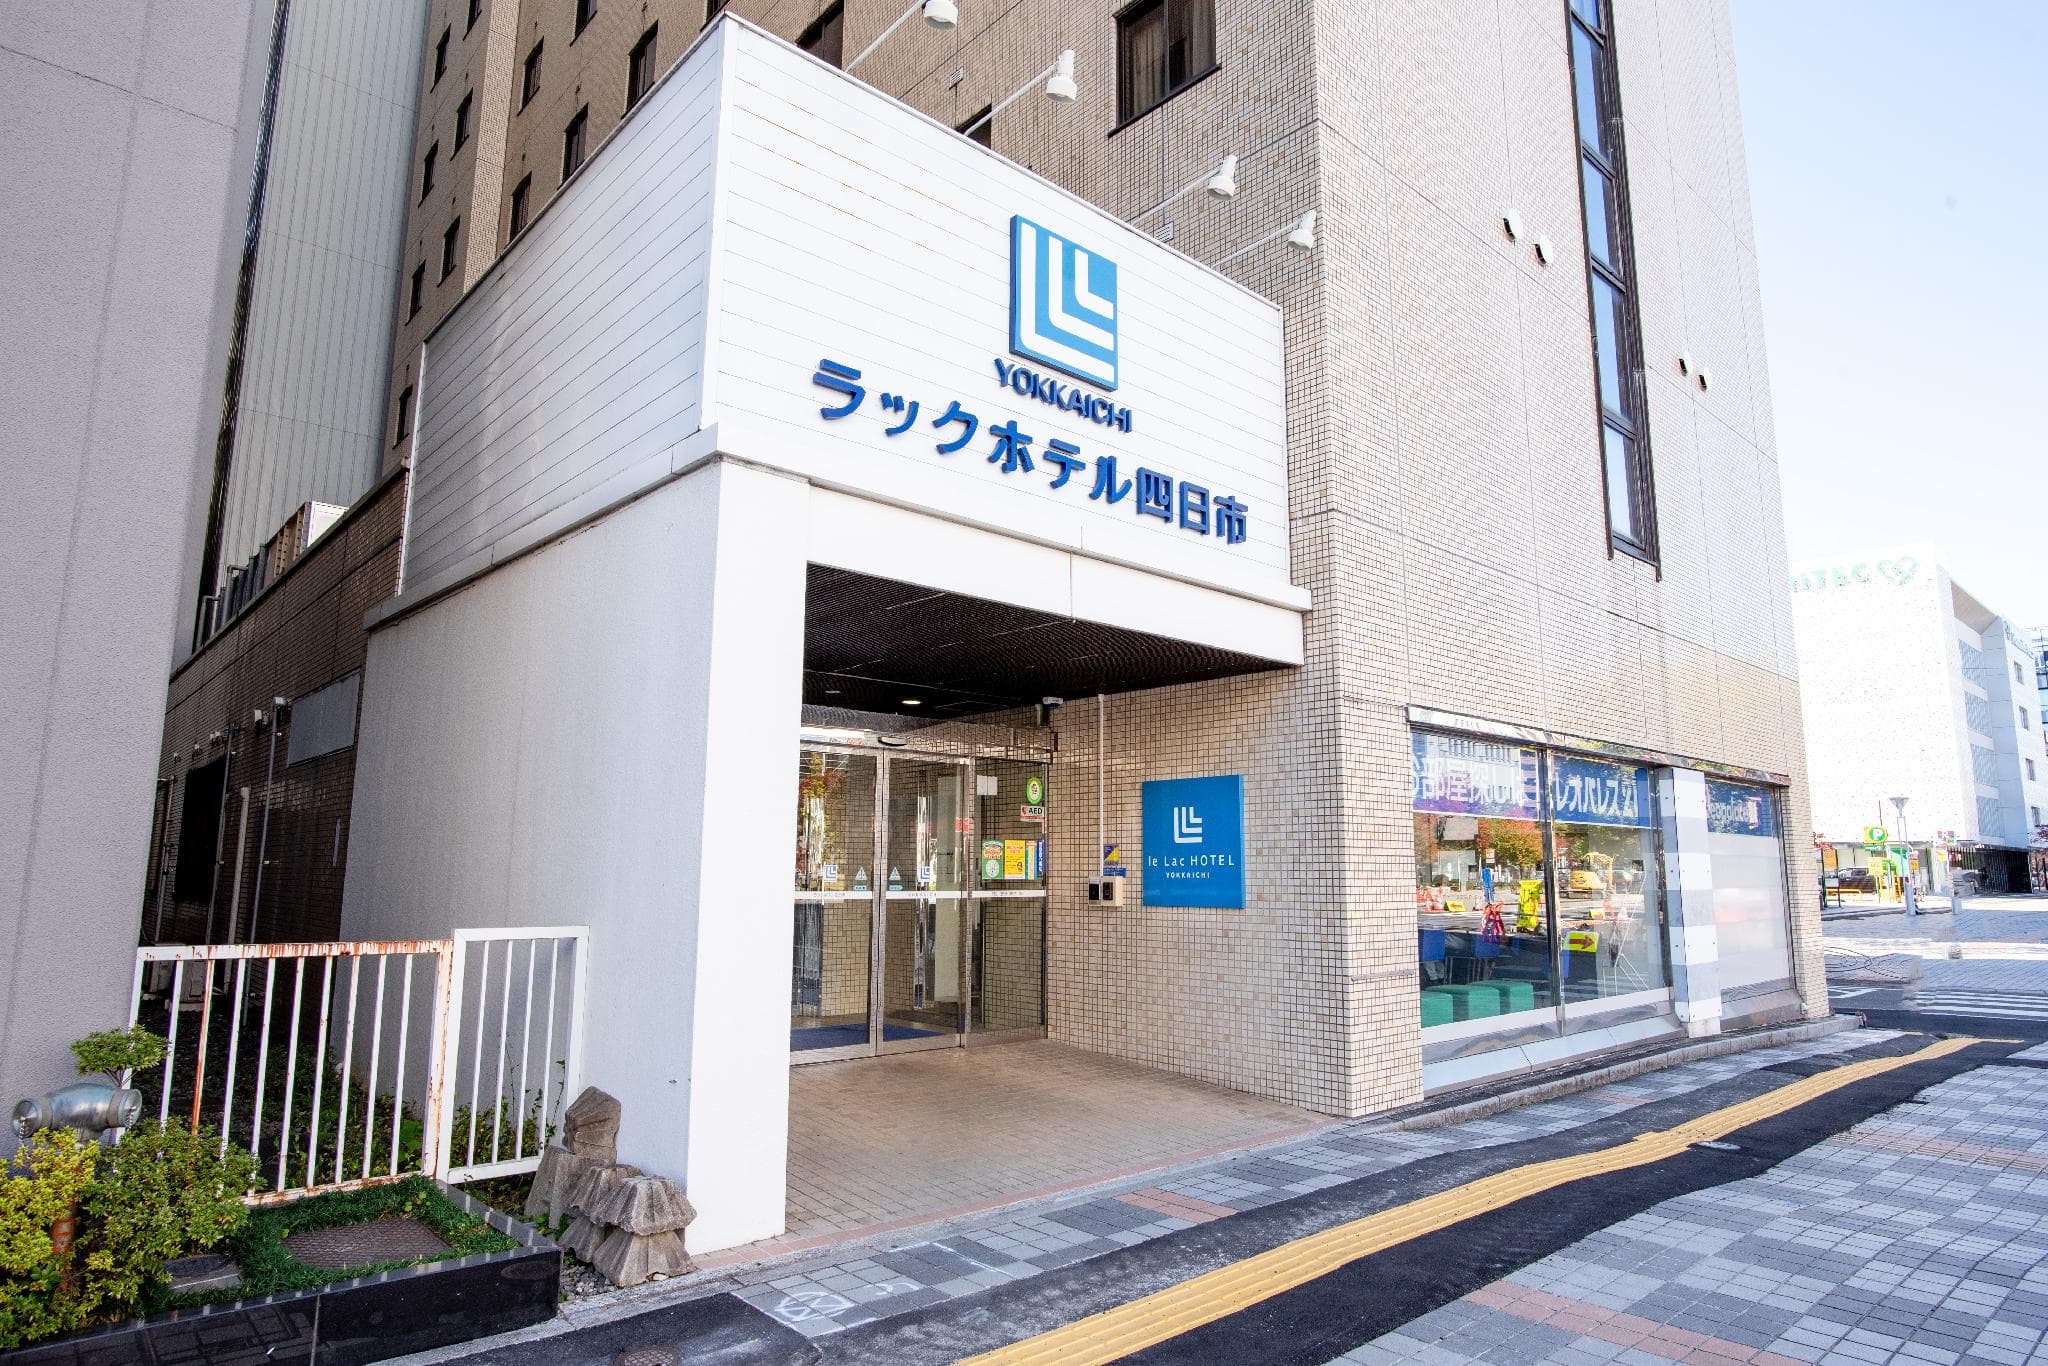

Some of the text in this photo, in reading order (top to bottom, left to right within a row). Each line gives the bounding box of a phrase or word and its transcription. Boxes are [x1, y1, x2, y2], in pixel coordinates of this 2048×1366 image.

[994, 358, 1132, 432] YOKKAICHI
[813, 358, 1248, 544] ラックホテル四日市
[1028, 807, 1043, 815] AED
[1872, 828, 1884, 841] P
[1148, 854, 1235, 867] le Lac HOTEL
[1165, 871, 1210, 879] YOKKAICHI
